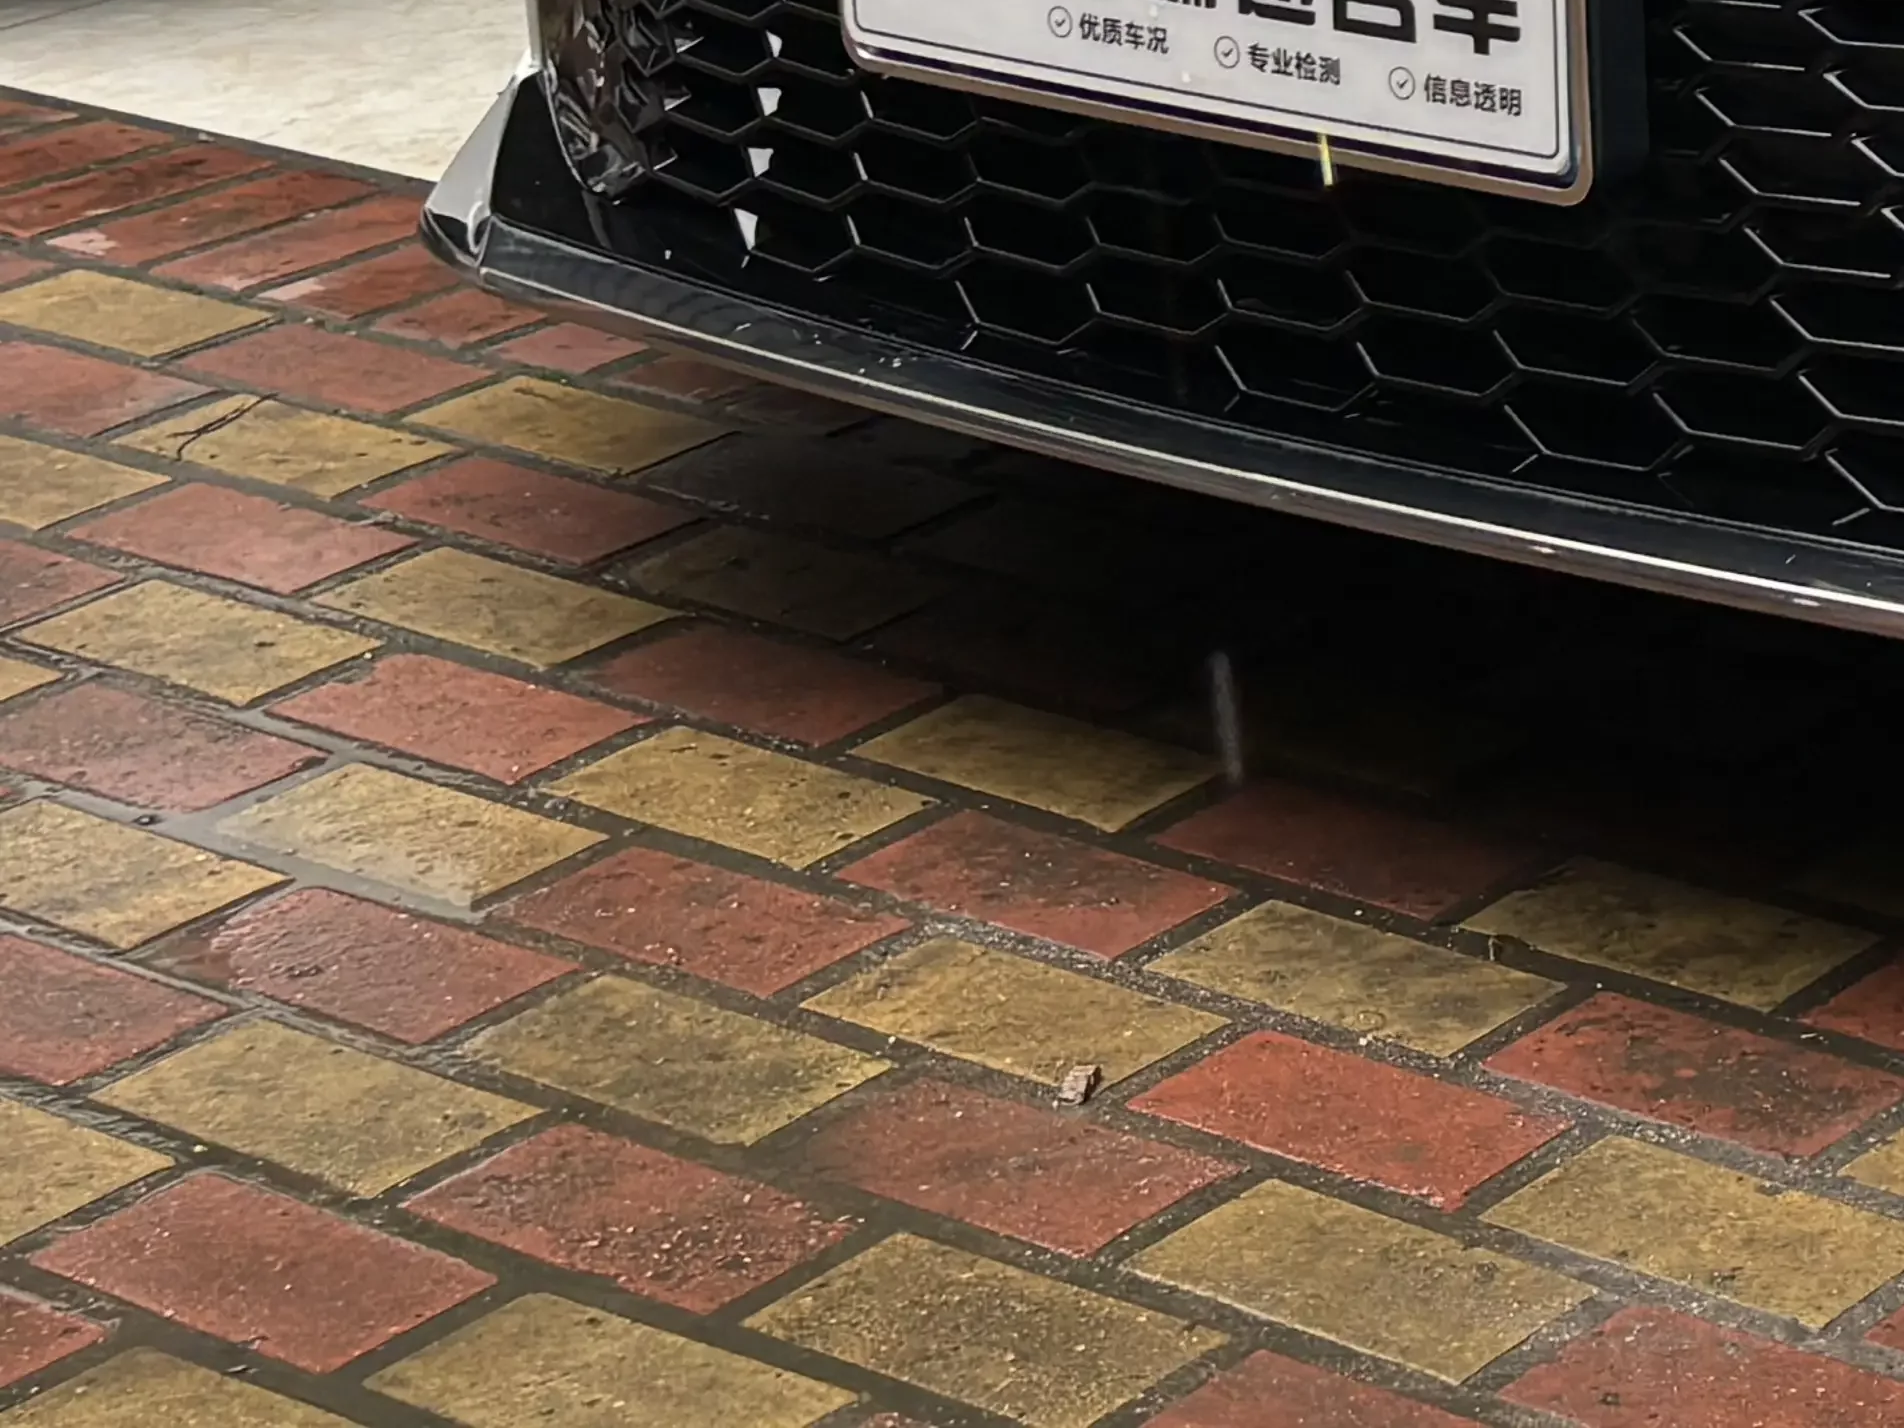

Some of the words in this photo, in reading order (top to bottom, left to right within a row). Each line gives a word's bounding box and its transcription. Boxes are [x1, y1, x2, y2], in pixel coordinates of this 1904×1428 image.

[1078, 12, 1170, 54] 优质车况
[1247, 43, 1341, 86] 专业检测
[1423, 73, 1523, 117] 信息透明
